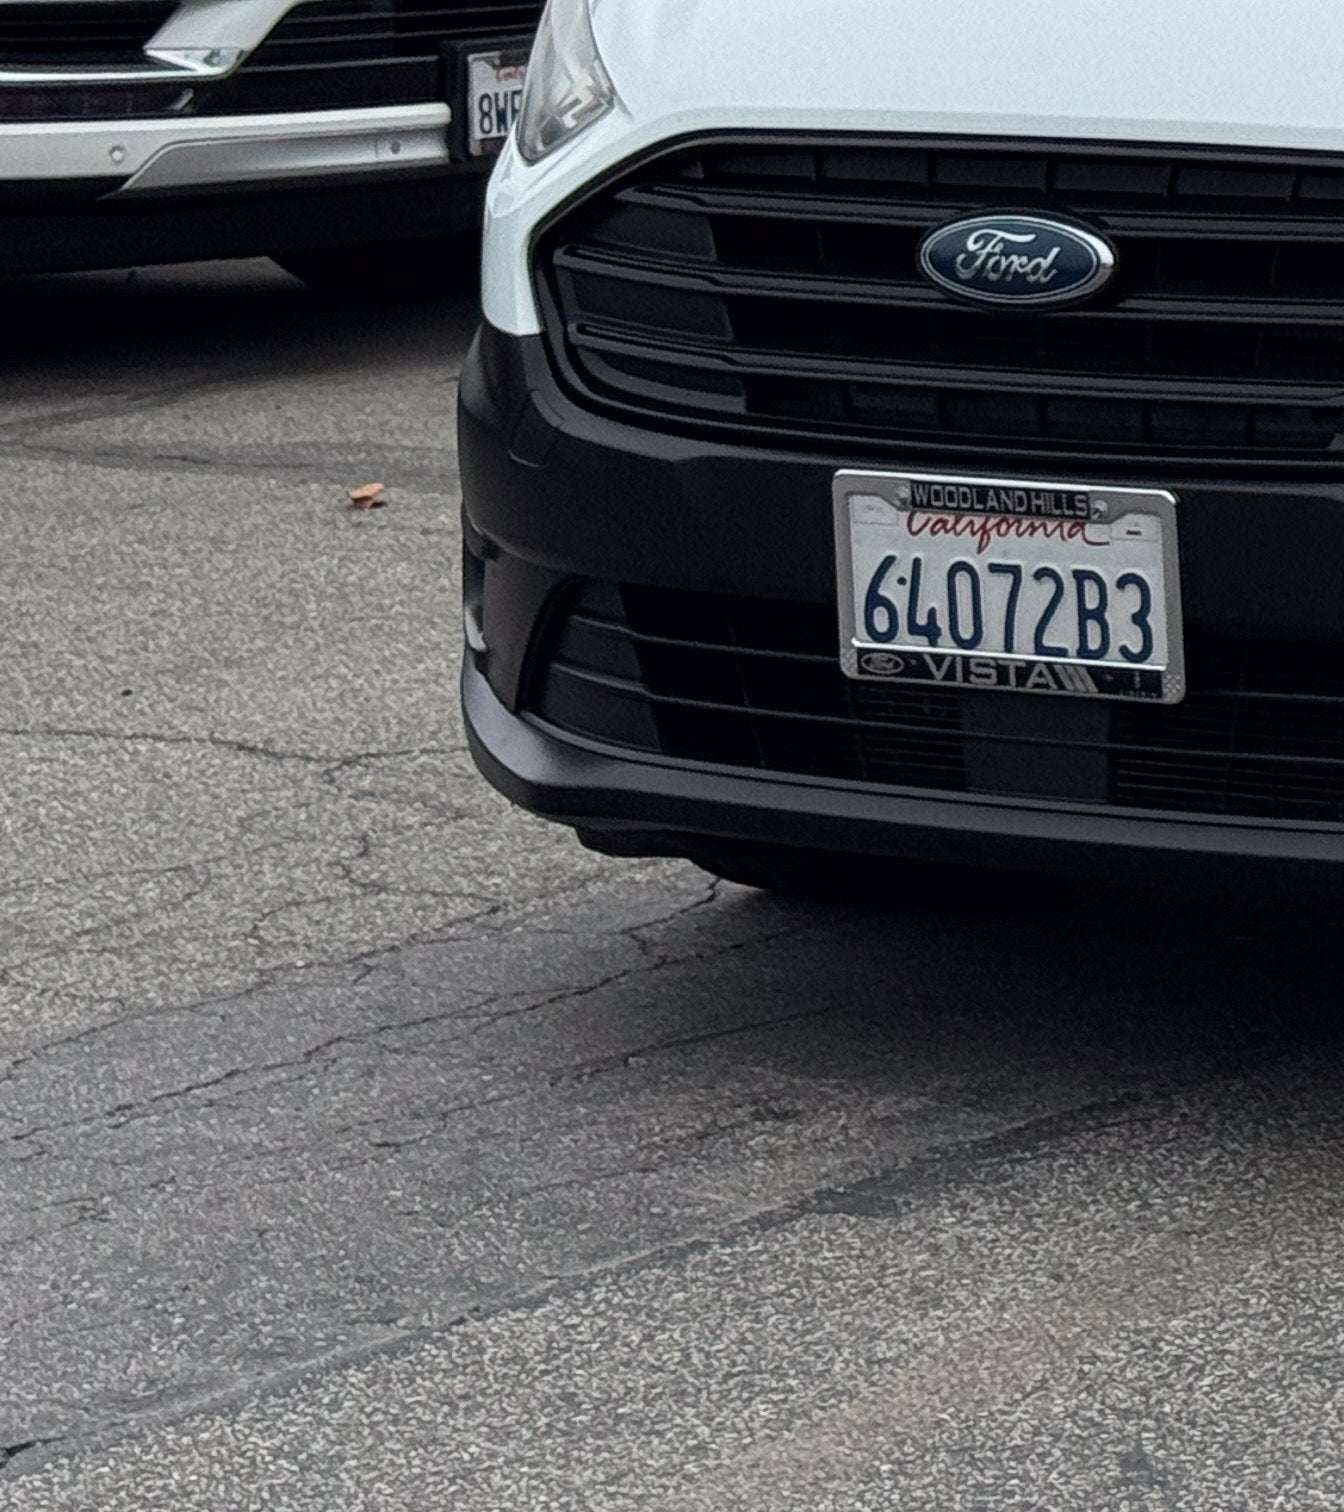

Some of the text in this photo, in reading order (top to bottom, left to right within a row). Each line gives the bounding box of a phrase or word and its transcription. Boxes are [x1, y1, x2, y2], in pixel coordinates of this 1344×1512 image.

[955, 227, 1062, 285] Ford
[911, 482, 1090, 517] WOODLAND HILLS
[907, 509, 1111, 555] California
[864, 554, 1154, 664] 64072B3
[922, 653, 1059, 690] VISTA
